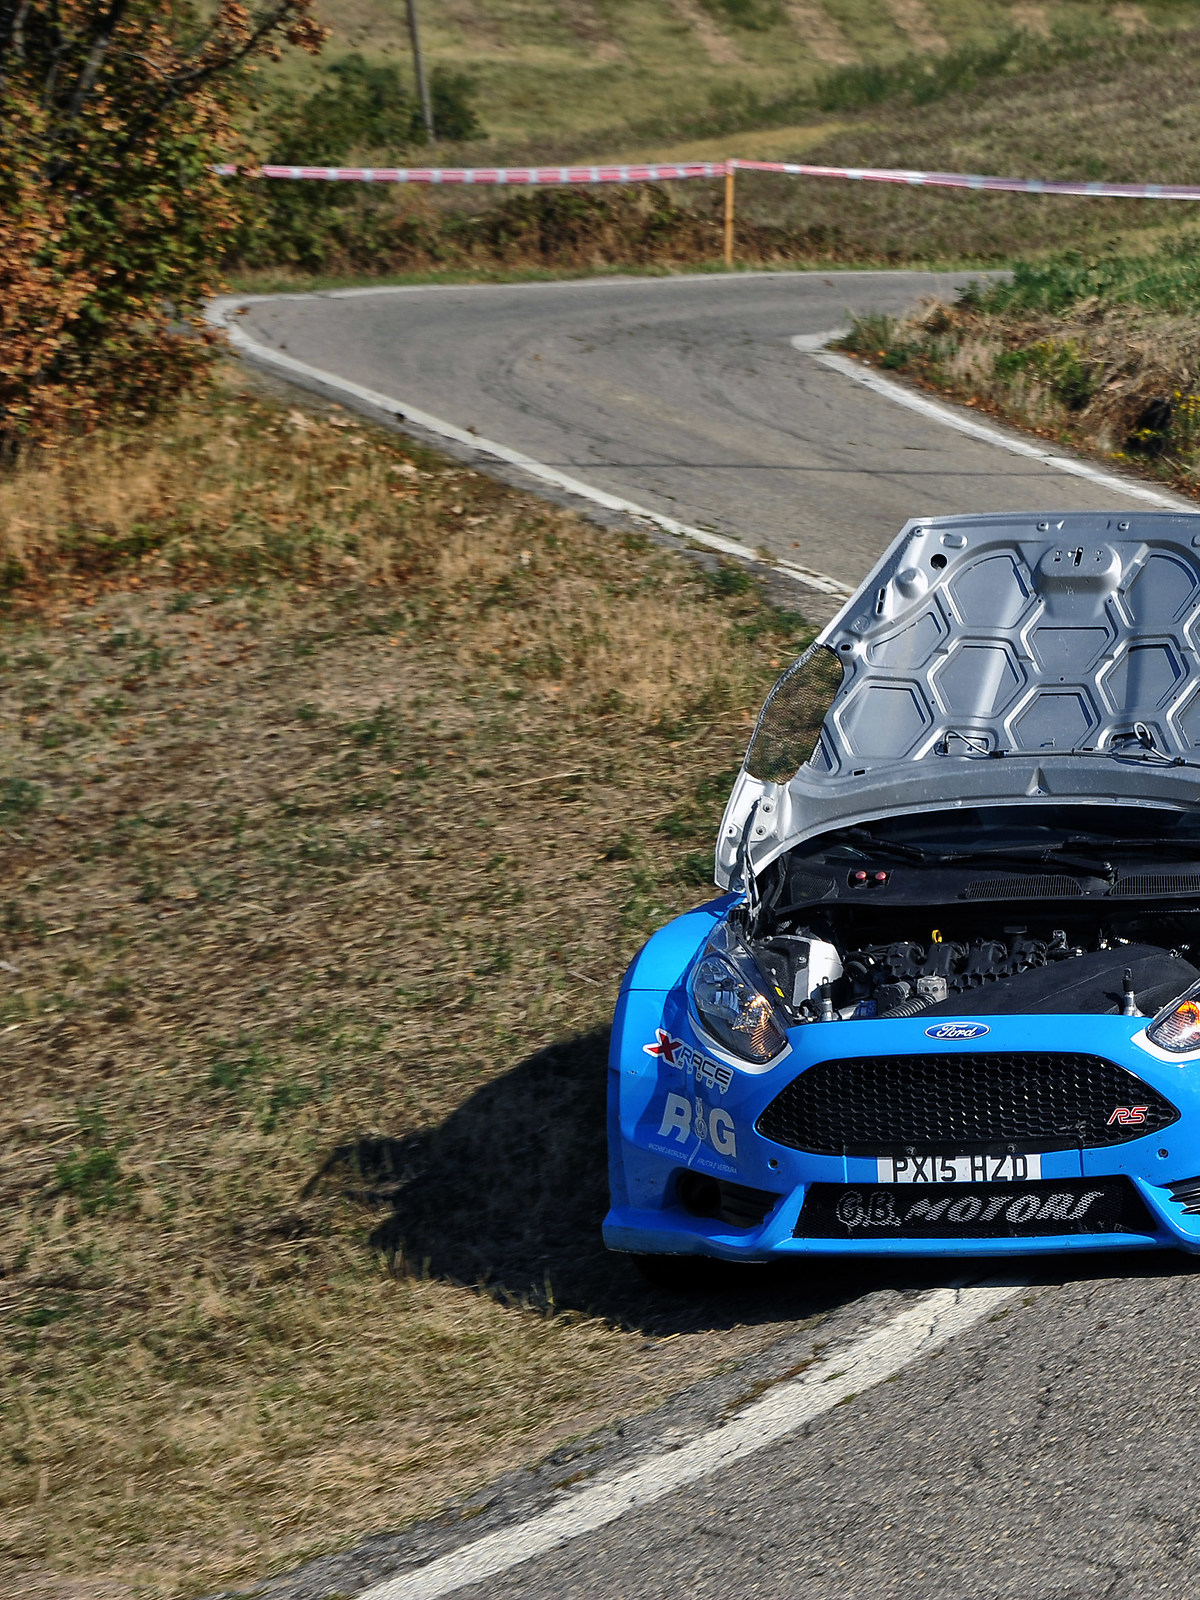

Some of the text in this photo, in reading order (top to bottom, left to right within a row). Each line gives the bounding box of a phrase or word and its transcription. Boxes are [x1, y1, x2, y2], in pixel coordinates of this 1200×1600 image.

[1106, 1106, 1149, 1125] RS
[892, 1154, 1028, 1182] PX15 HZD
[904, 1191, 1104, 1224] MOTORS
